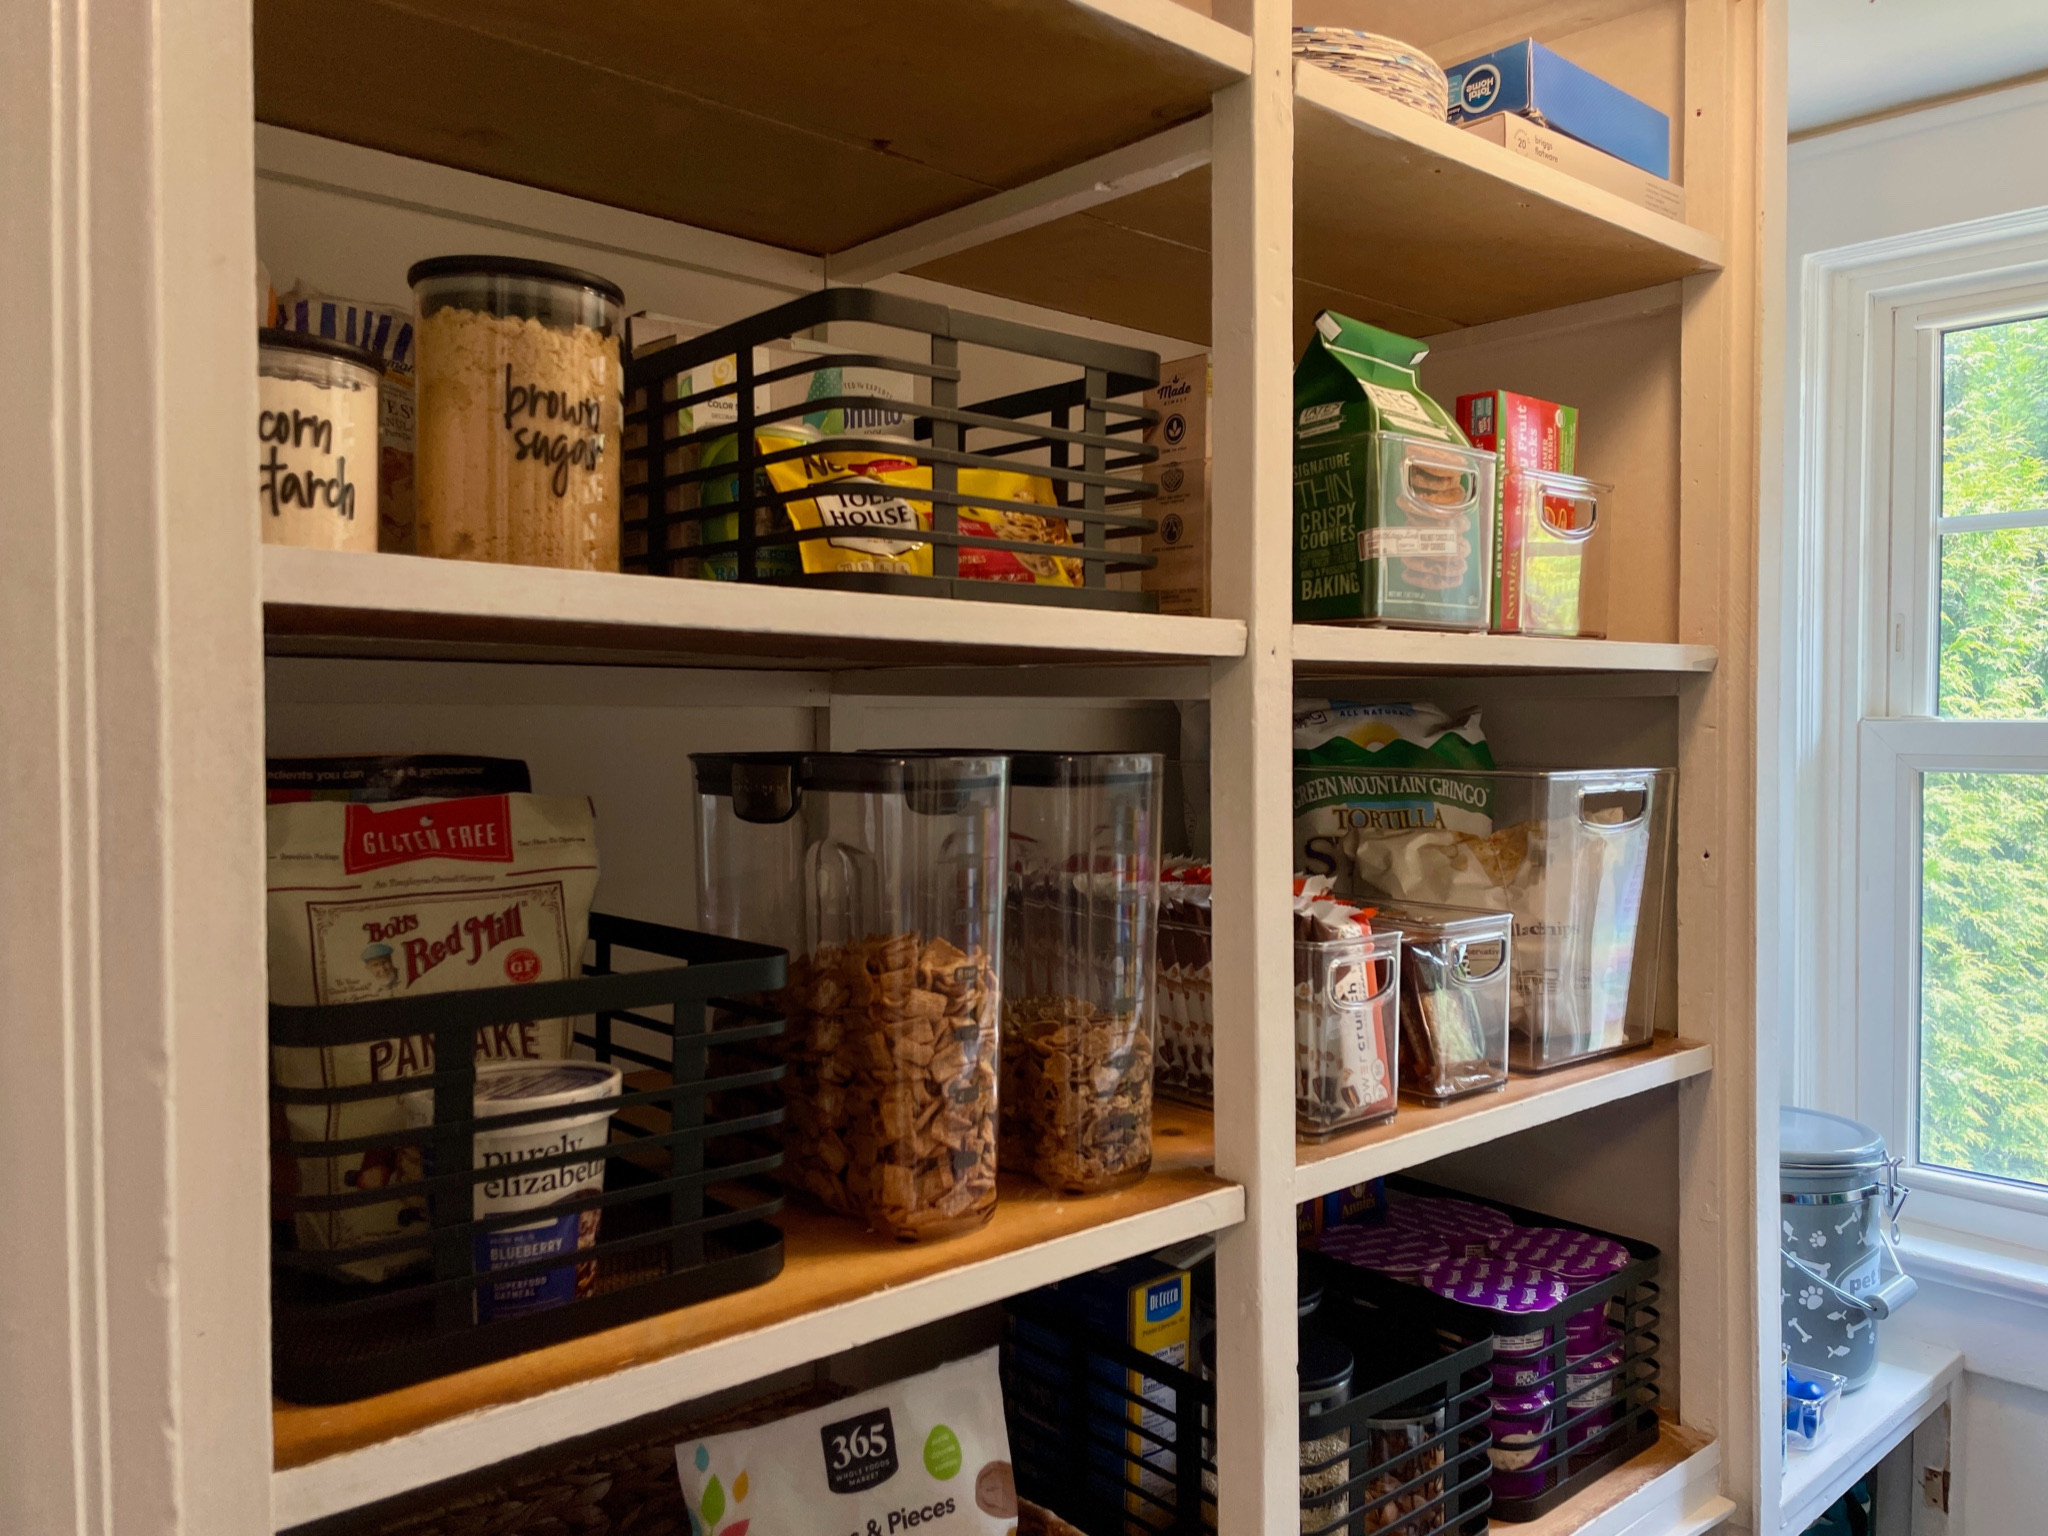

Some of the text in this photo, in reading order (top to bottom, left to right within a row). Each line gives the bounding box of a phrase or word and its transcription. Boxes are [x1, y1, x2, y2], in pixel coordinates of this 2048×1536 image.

[1466, 76, 1495, 94] Home
[1467, 86, 1493, 102] Total
[504, 362, 600, 432] brown
[1157, 381, 1192, 400] Made
[707, 400, 734, 411] COLOR
[258, 408, 333, 455] corn
[1517, 404, 1528, 452] Fruit
[513, 425, 604, 499] sugar
[1529, 428, 1539, 470] acks
[1294, 451, 1351, 479] SIGNATURE
[257, 446, 356, 521] tarch
[1294, 469, 1355, 510] THIN
[829, 505, 912, 527] HOUSE
[1300, 501, 1357, 534] CRISPY
[1300, 524, 1357, 551] COOKIES
[1301, 572, 1361, 601] BAKING
[1339, 709, 1358, 718] ALL
[1339, 775, 1428, 795] MOUNTAIN
[1429, 776, 1488, 808] GRINGO
[1332, 808, 1446, 830] TORTILLA
[445, 822, 498, 851] FREE
[401, 902, 525, 990] Red Mill
[509, 960, 536, 974] GF
[490, 1239, 563, 1262] BLUEBERRY
[1849, 1269, 1877, 1296] pet
[831, 1422, 889, 1471] 365
[836, 1468, 863, 1483] WHOLE
[848, 1471, 880, 1487] MARKET
[867, 1497, 956, 1536] & Pieces
